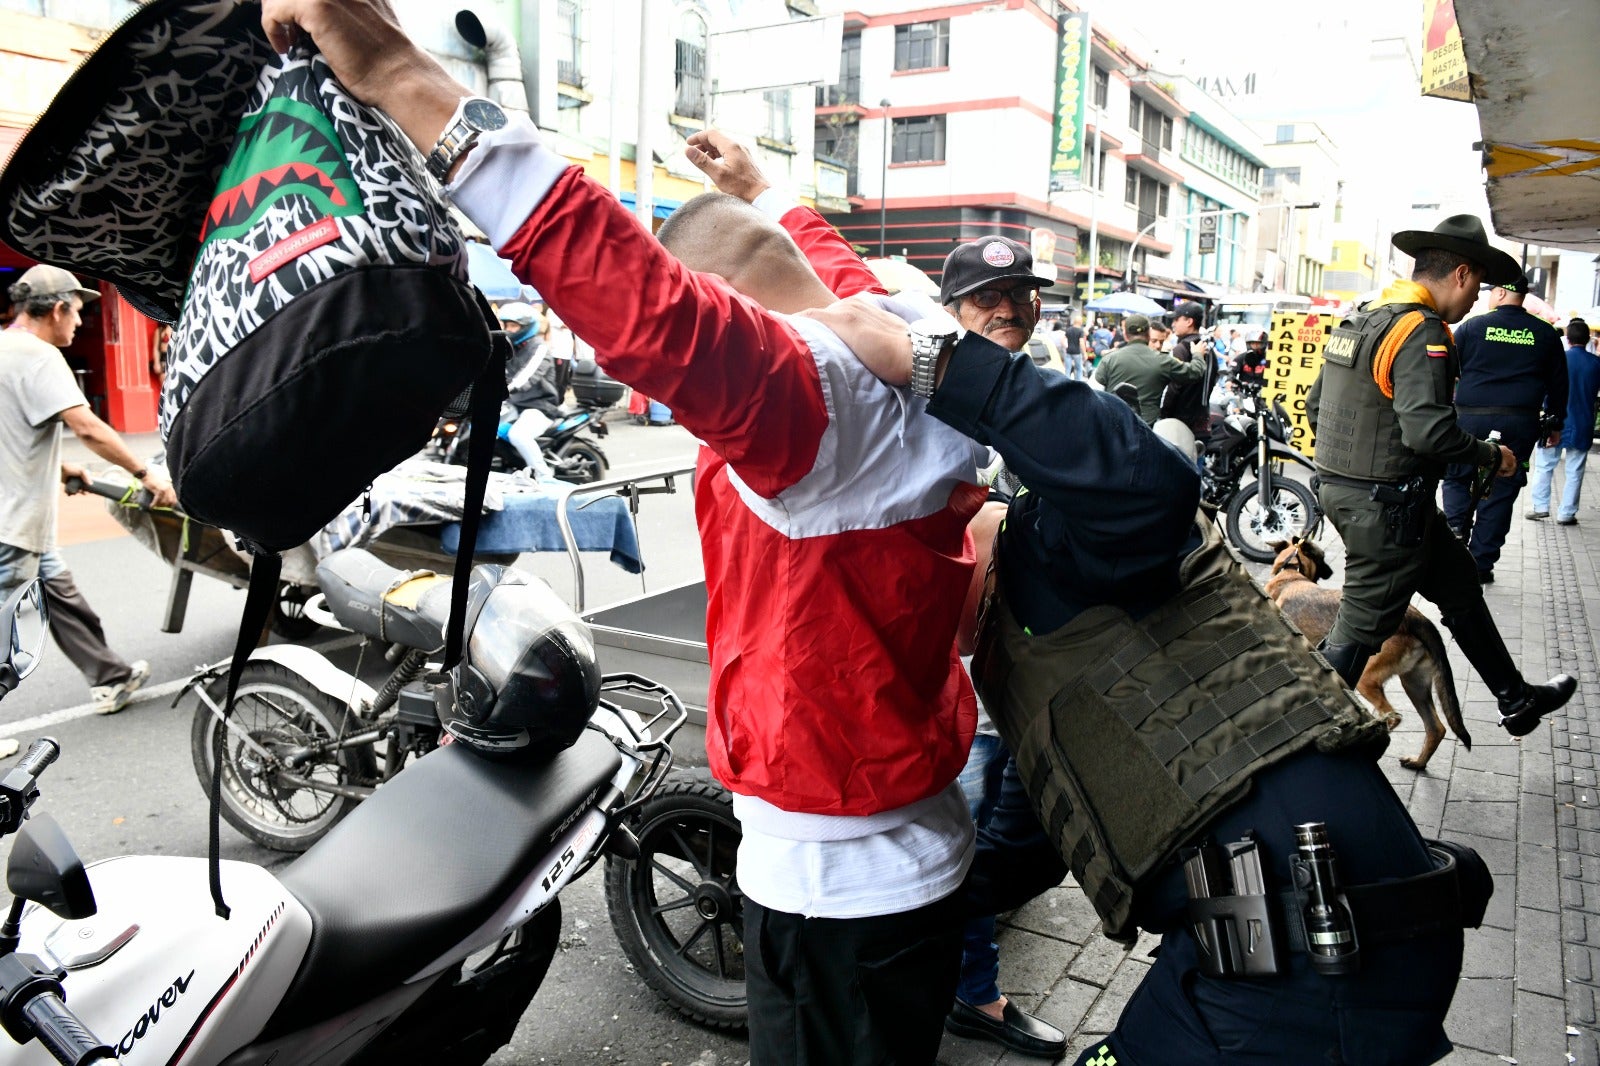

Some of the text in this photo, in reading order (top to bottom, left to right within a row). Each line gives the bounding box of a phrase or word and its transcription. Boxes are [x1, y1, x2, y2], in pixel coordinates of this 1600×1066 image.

[1433, 41, 1460, 60] DESDE:
[1432, 59, 1460, 76] HASTA:
[1297, 335, 1321, 343] ROJO
[1298, 328, 1322, 336] GATO
[541, 845, 575, 893] 125
[113, 968, 195, 1060] cover
